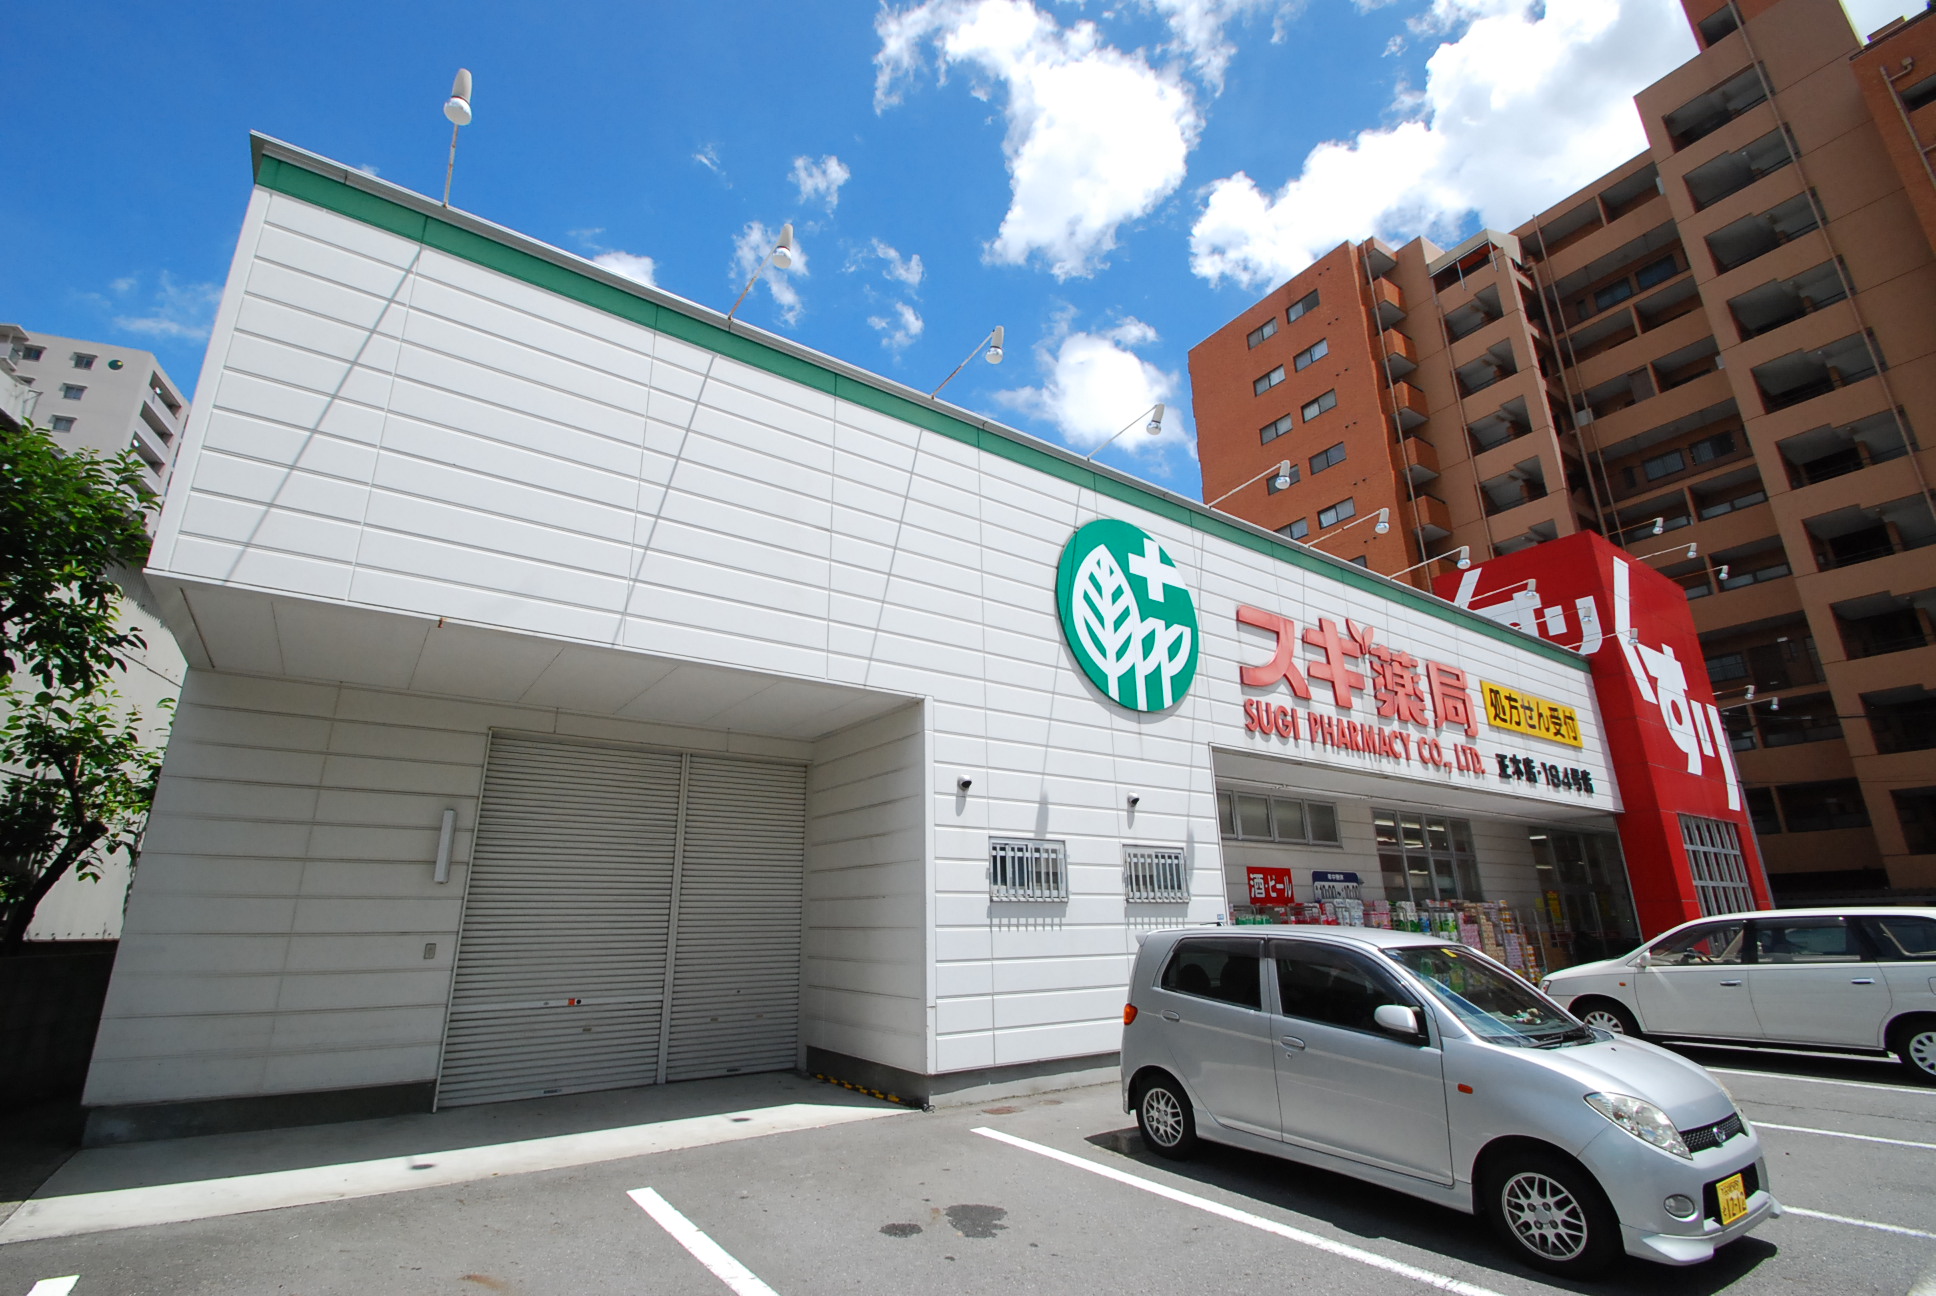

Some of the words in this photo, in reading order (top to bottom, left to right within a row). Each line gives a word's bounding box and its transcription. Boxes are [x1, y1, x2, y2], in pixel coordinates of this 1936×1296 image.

[1237, 605, 1479, 737] スギ薬局
[1490, 688, 1577, 741] 処方せん受付
[1613, 557, 1740, 811] くすり
[1245, 699, 1301, 740] SUGI
[1309, 712, 1411, 760] PHARMACY
[1454, 744, 1486, 774] LTD.
